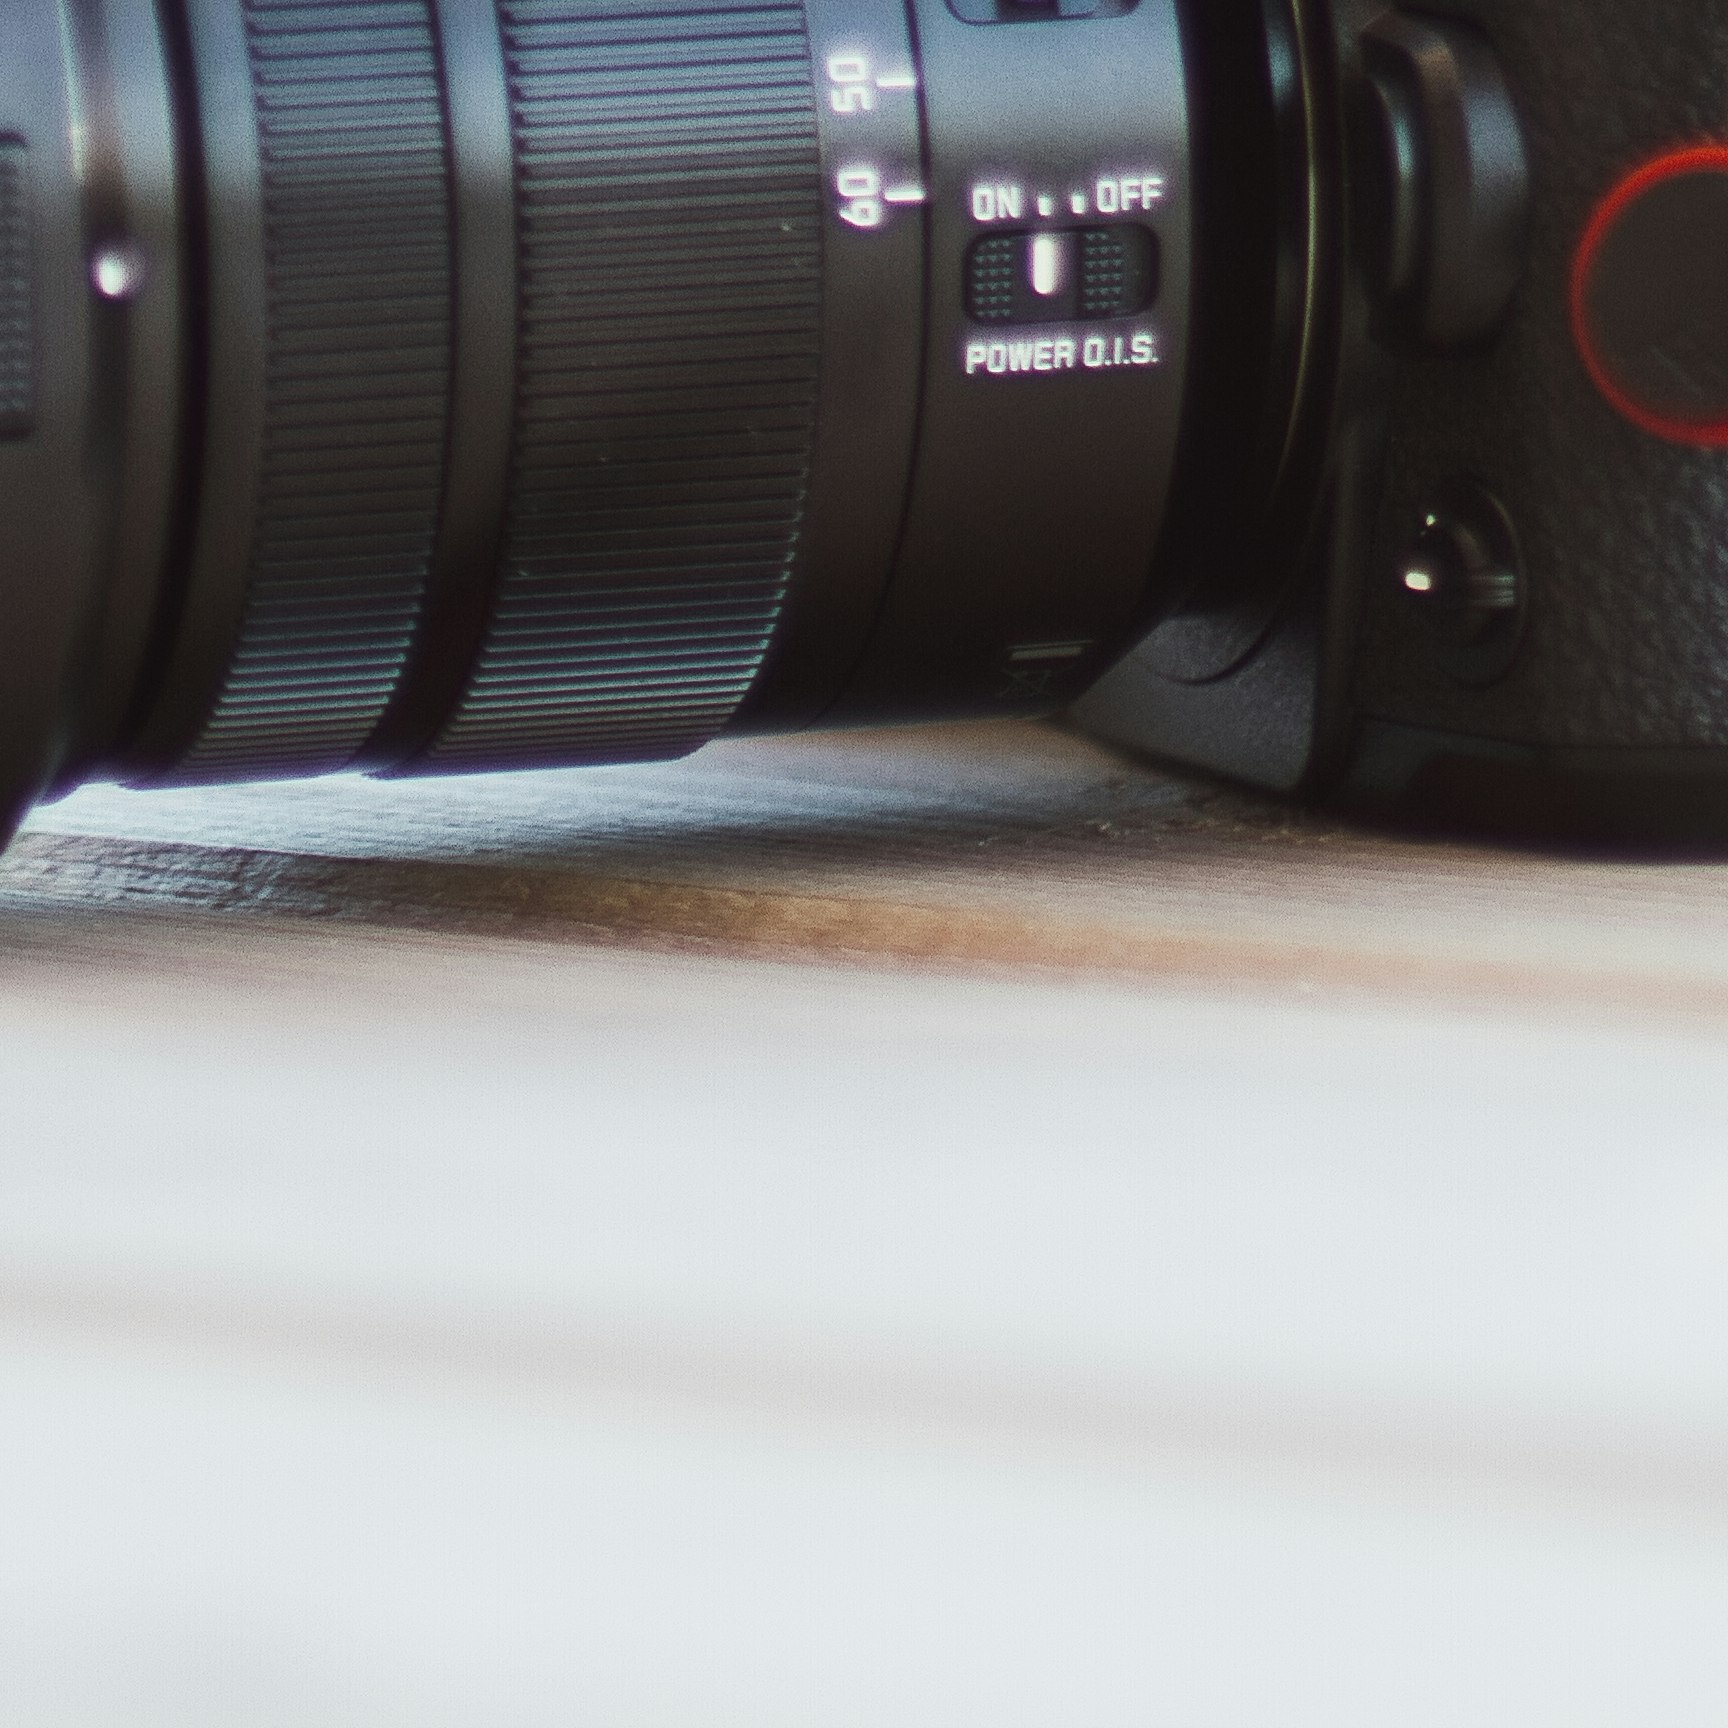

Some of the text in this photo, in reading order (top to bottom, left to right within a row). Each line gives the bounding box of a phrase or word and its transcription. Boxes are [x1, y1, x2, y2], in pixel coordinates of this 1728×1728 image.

[828, 56, 874, 113] 50
[837, 168, 881, 227] 60
[972, 176, 1164, 221] ON OFF
[965, 331, 1161, 375] POWER O.I.S.
